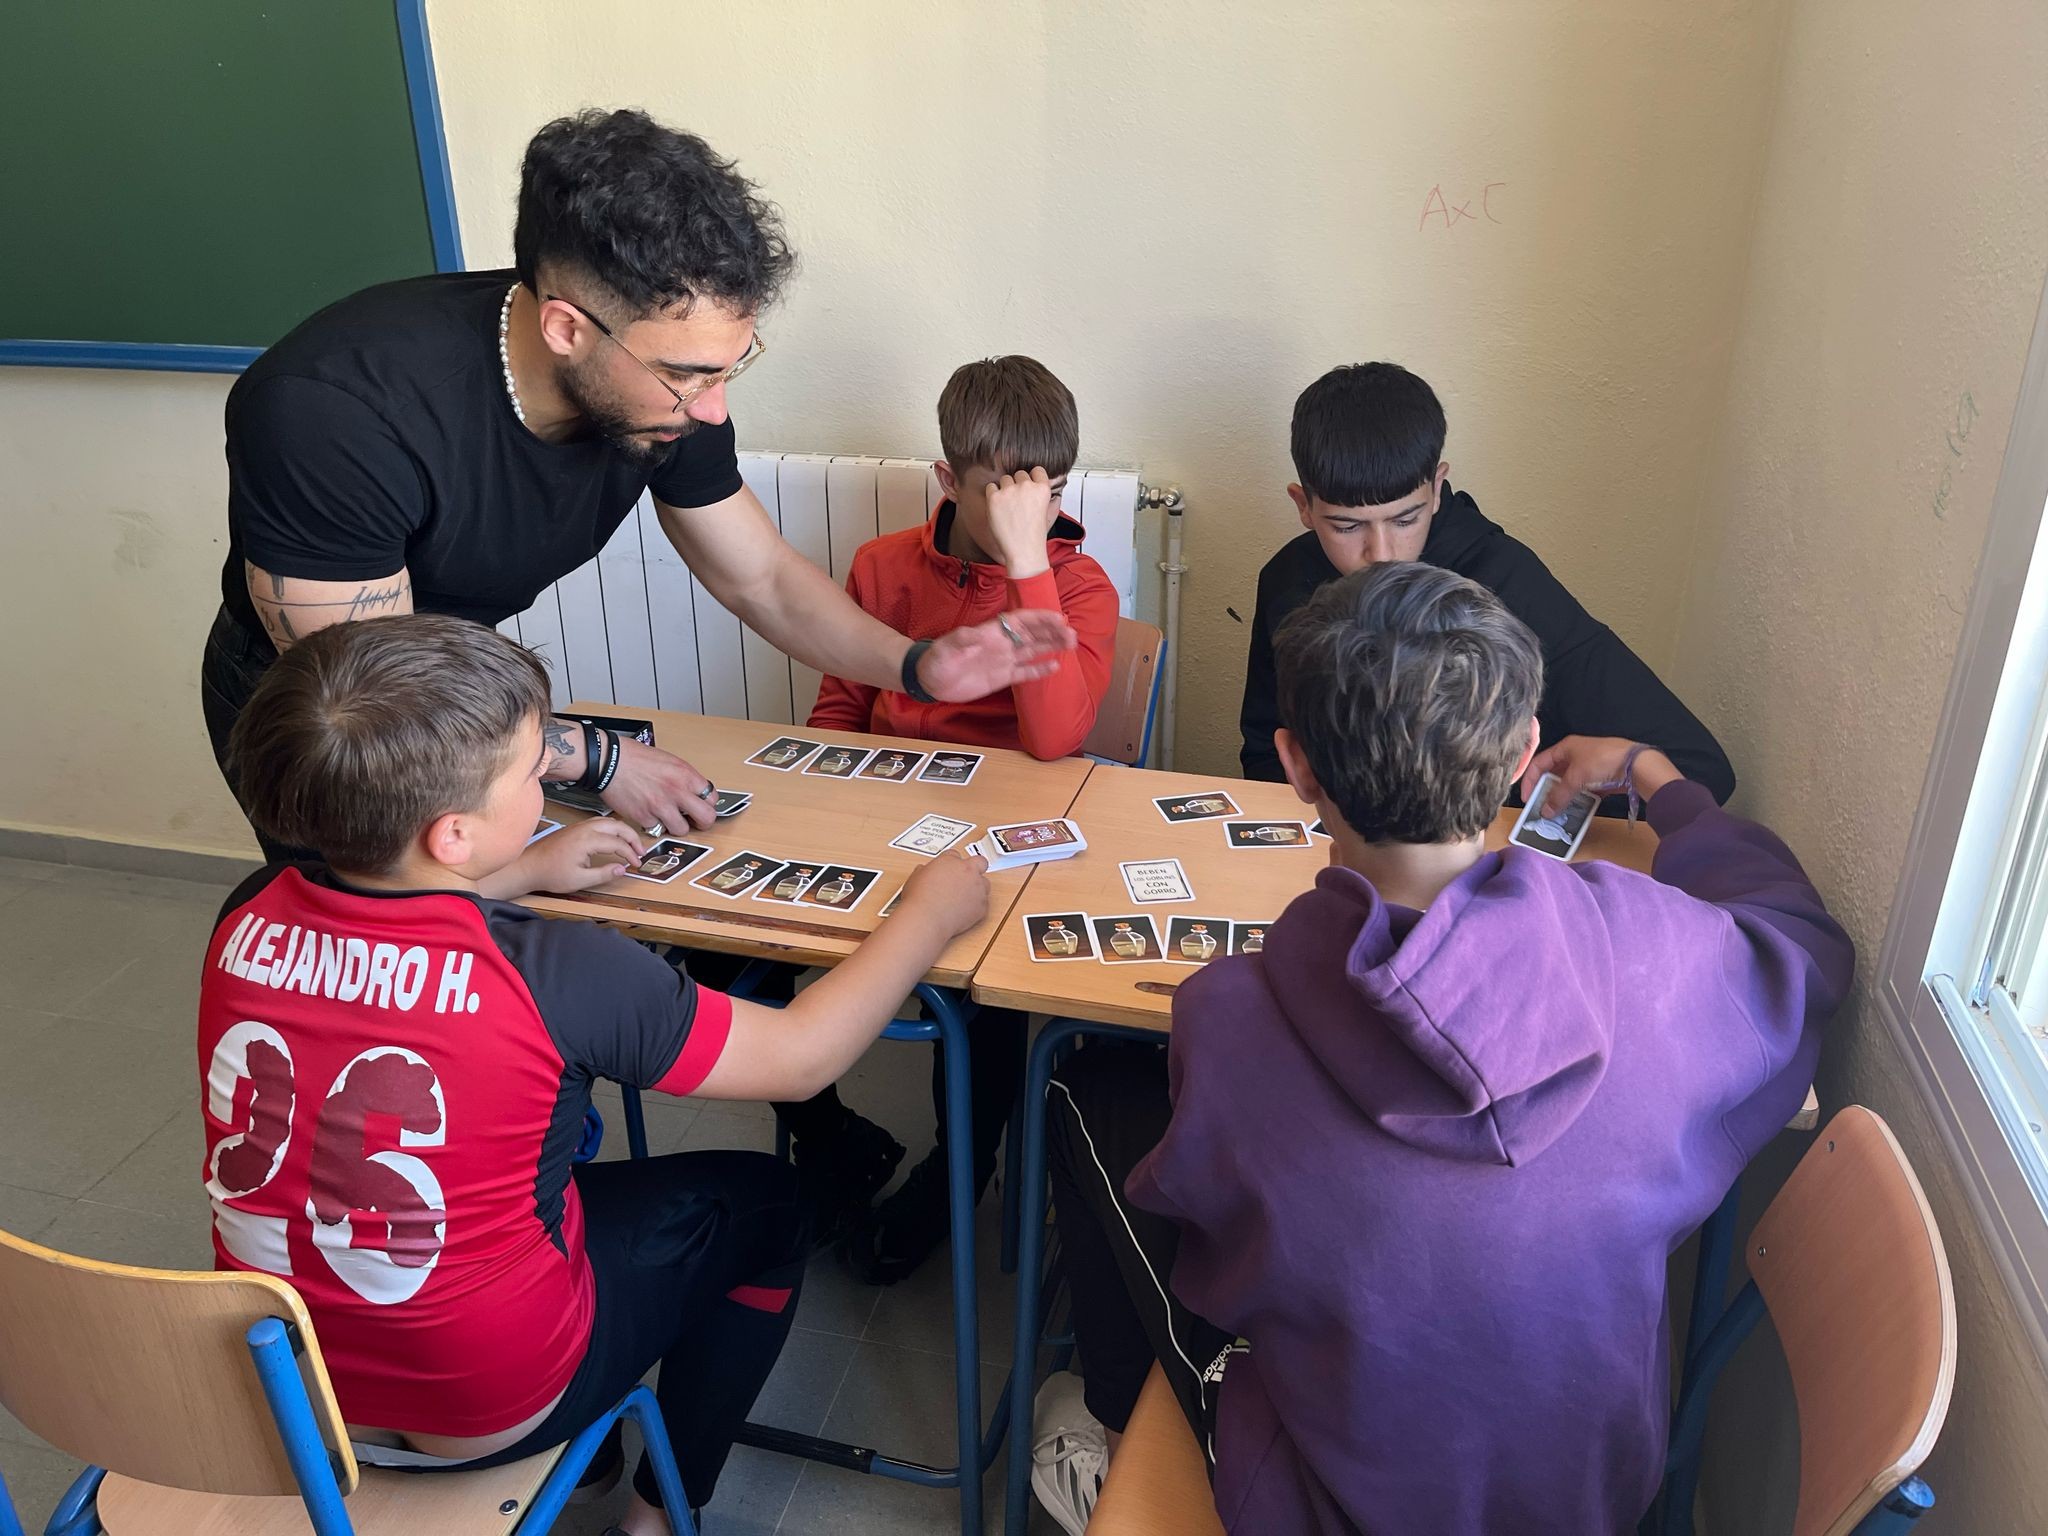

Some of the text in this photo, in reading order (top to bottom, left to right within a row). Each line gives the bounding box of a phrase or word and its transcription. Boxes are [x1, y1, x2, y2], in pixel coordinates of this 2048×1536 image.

[1136, 868, 1167, 876] BEBEN
[1143, 887, 1177, 896] GORRO
[217, 911, 481, 1015] ALEJANDRO H.
[1202, 1343, 1233, 1383] adidas
